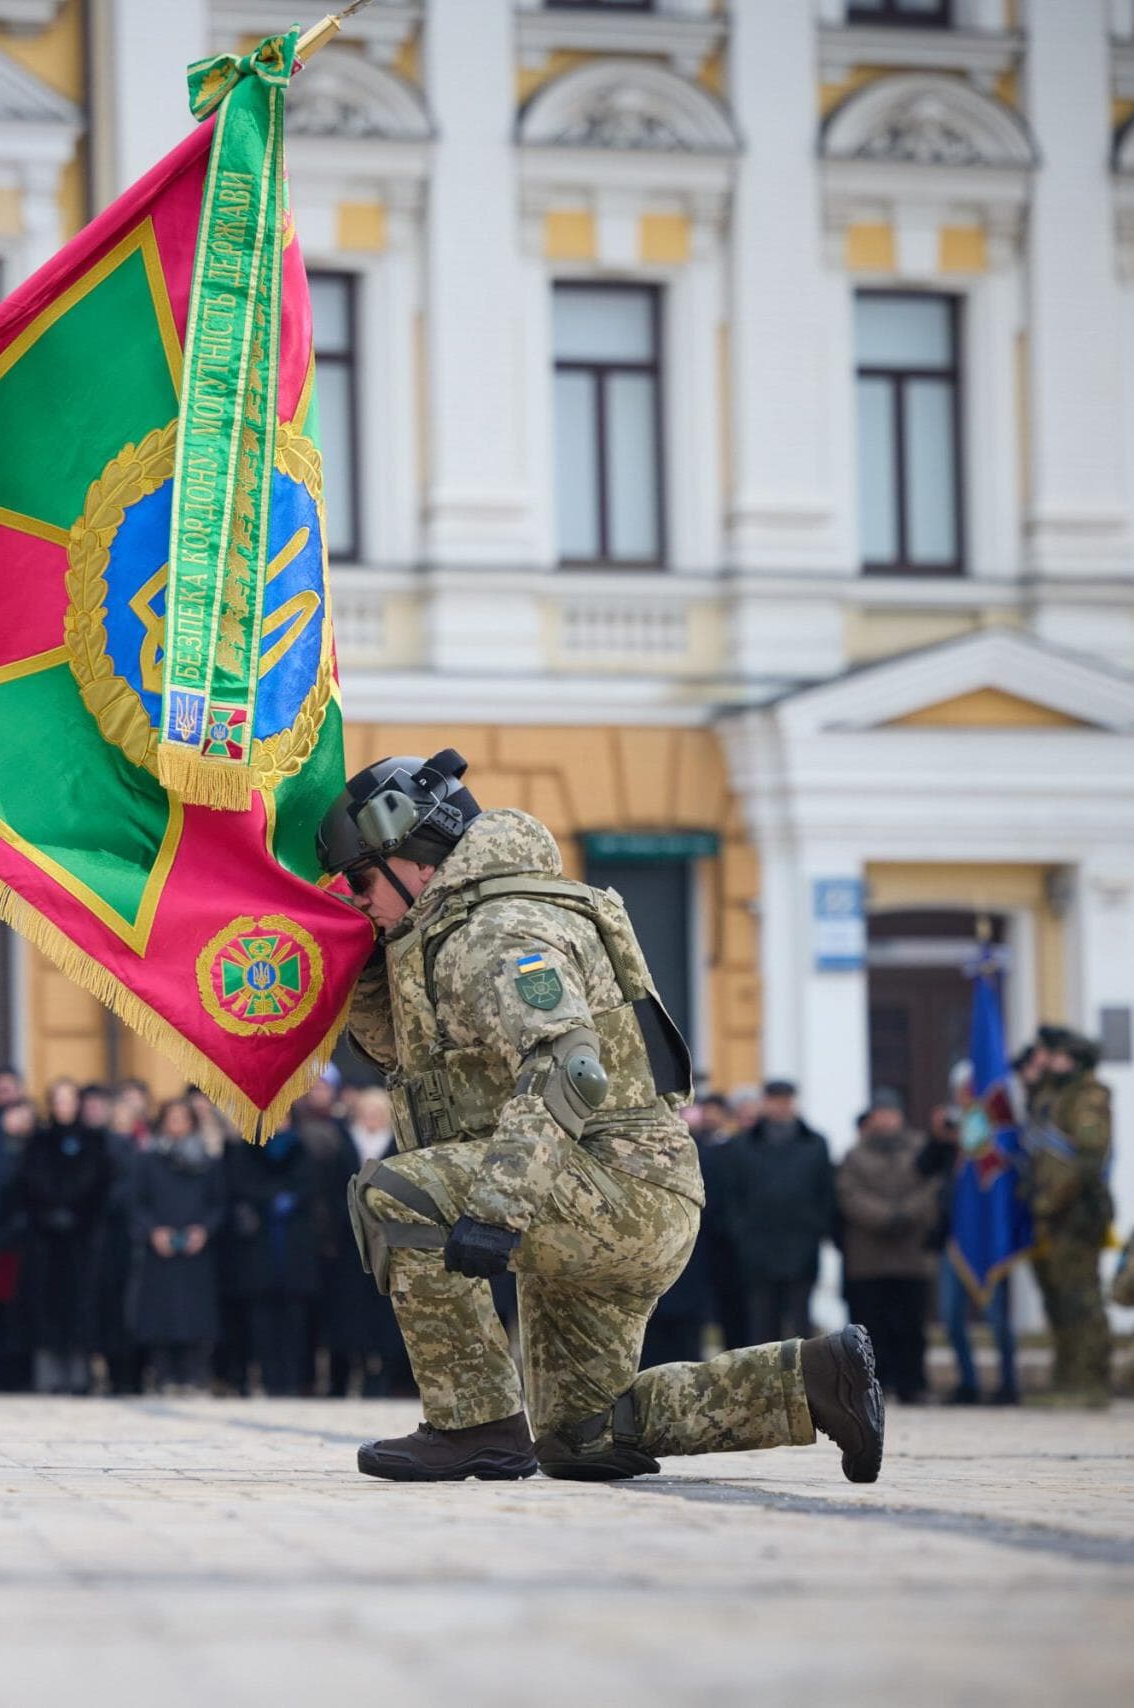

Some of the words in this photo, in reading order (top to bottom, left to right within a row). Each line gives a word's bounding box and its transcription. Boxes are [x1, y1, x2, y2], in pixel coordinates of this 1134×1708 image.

[208, 170, 254, 287] ДЕРЖАВИ
[190, 292, 237, 438] МОГУТНІСТЬ
[181, 446, 219, 566] КОРДОНУ.
[175, 573, 208, 680] БЕЗПЕКА
